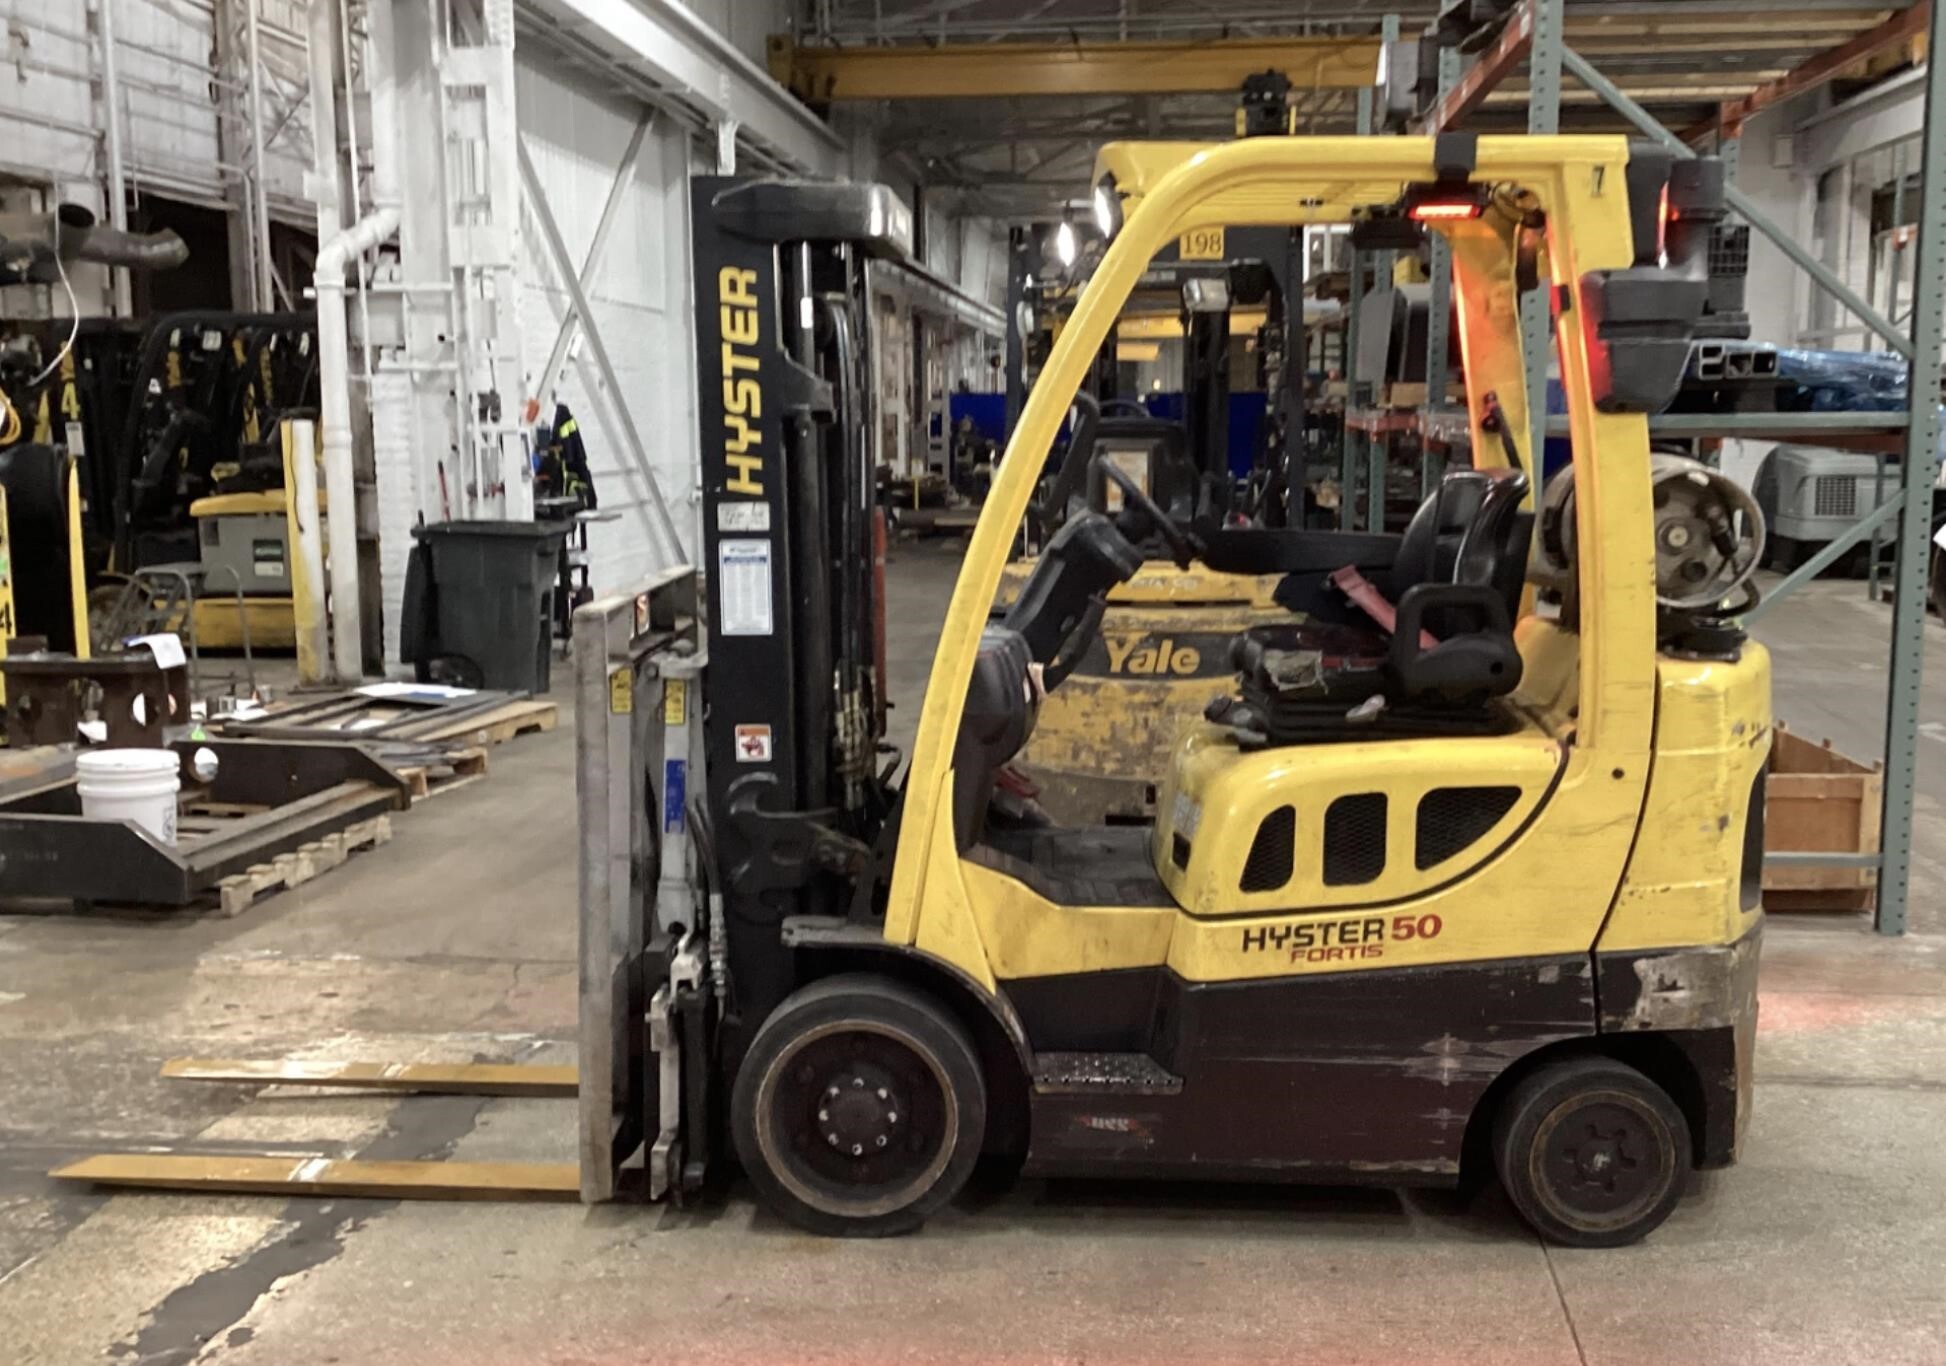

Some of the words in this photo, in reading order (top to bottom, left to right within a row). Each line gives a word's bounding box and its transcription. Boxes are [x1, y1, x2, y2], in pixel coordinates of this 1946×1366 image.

[1183, 232, 1222, 255] 198
[719, 265, 764, 496] HYSTER
[1105, 638, 1200, 674] Yale
[1242, 917, 1385, 953] HYSTER
[1391, 913, 1443, 942] 50
[1290, 943, 1384, 964] FORTIS
